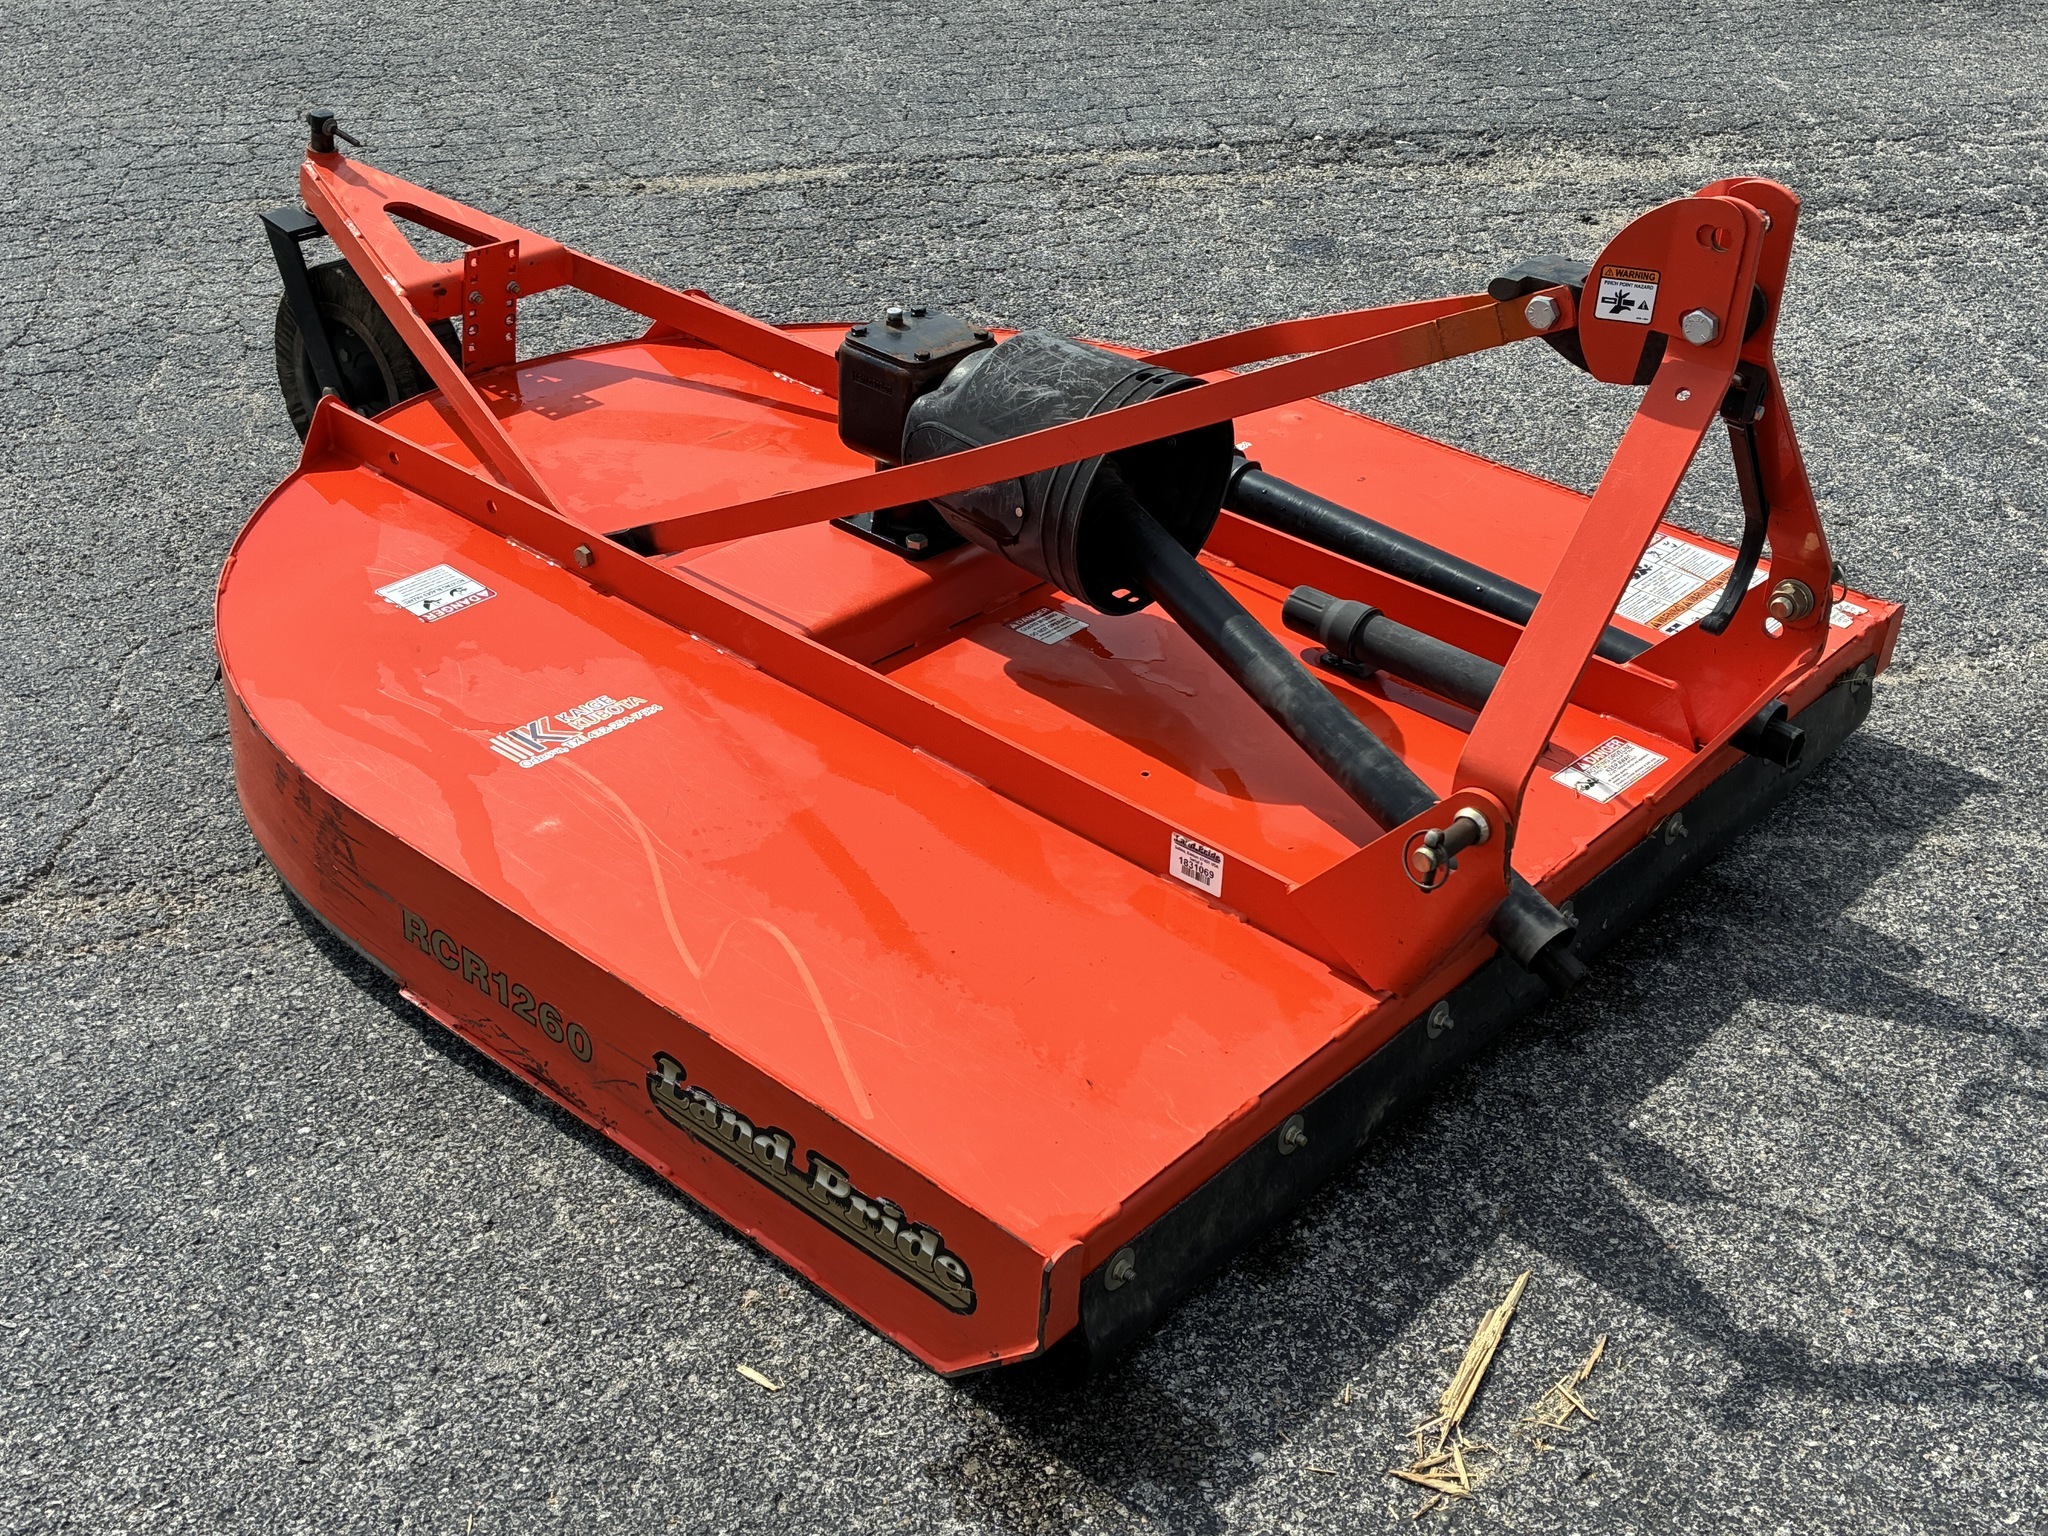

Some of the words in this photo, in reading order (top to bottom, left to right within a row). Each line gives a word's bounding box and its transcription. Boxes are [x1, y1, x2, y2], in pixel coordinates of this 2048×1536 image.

[1615, 268, 1656, 281] WARNING
[425, 594, 482, 621] DANGER
[1013, 607, 1051, 624] DANGER
[568, 696, 648, 730] KUBOTA
[1584, 738, 1625, 766] DANGER
[1199, 845, 1220, 861] Pride
[1179, 857, 1214, 879] 1831069
[402, 909, 593, 1063] RCR1260
[650, 1056, 792, 1176] Land
[807, 1157, 968, 1292] Pride
